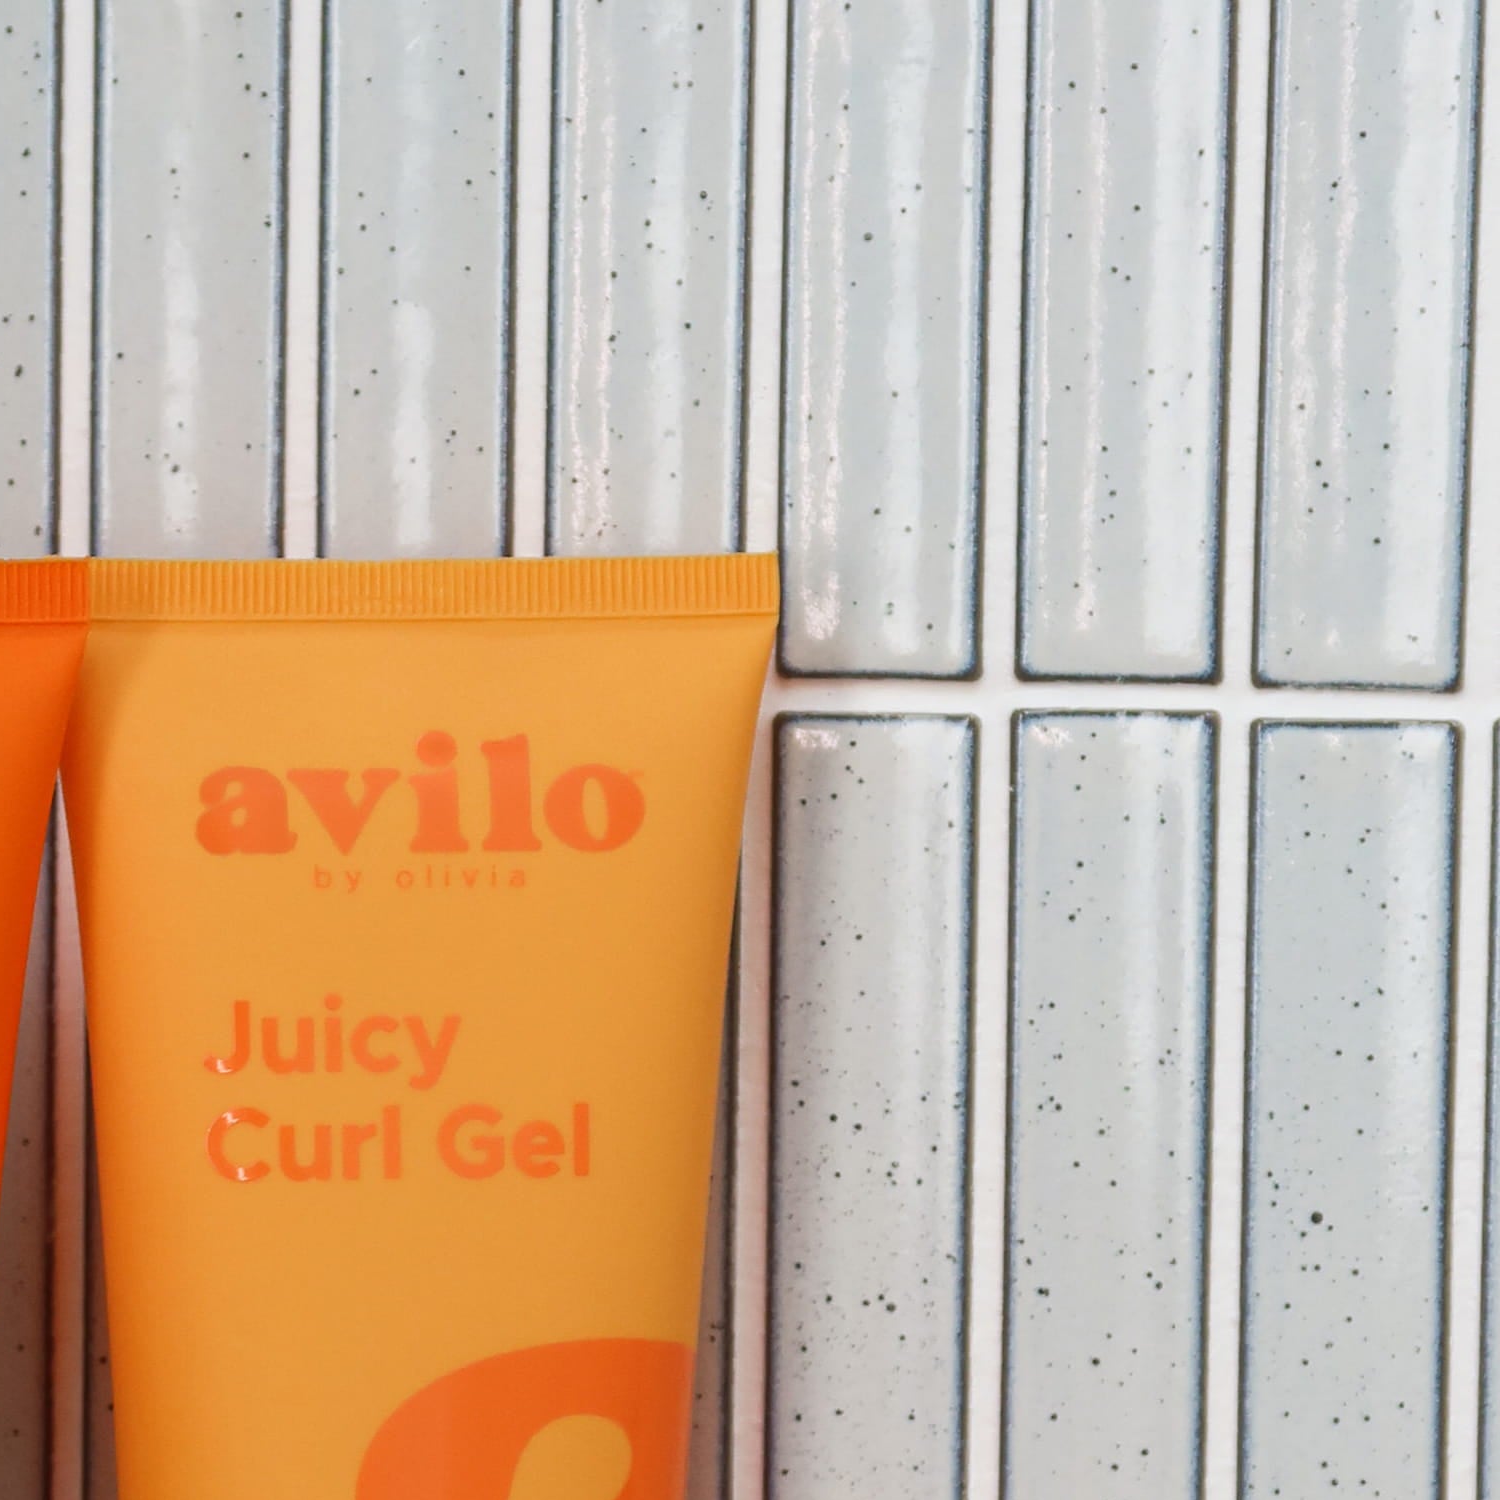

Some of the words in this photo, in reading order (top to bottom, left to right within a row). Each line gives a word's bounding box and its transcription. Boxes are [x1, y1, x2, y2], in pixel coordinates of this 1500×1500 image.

[195, 730, 646, 856] avilo
[313, 865, 363, 893] by
[396, 866, 527, 890] olivia
[203, 994, 462, 1090] Juicy
[207, 1105, 402, 1183] Curl
[437, 1103, 590, 1179] Gel
